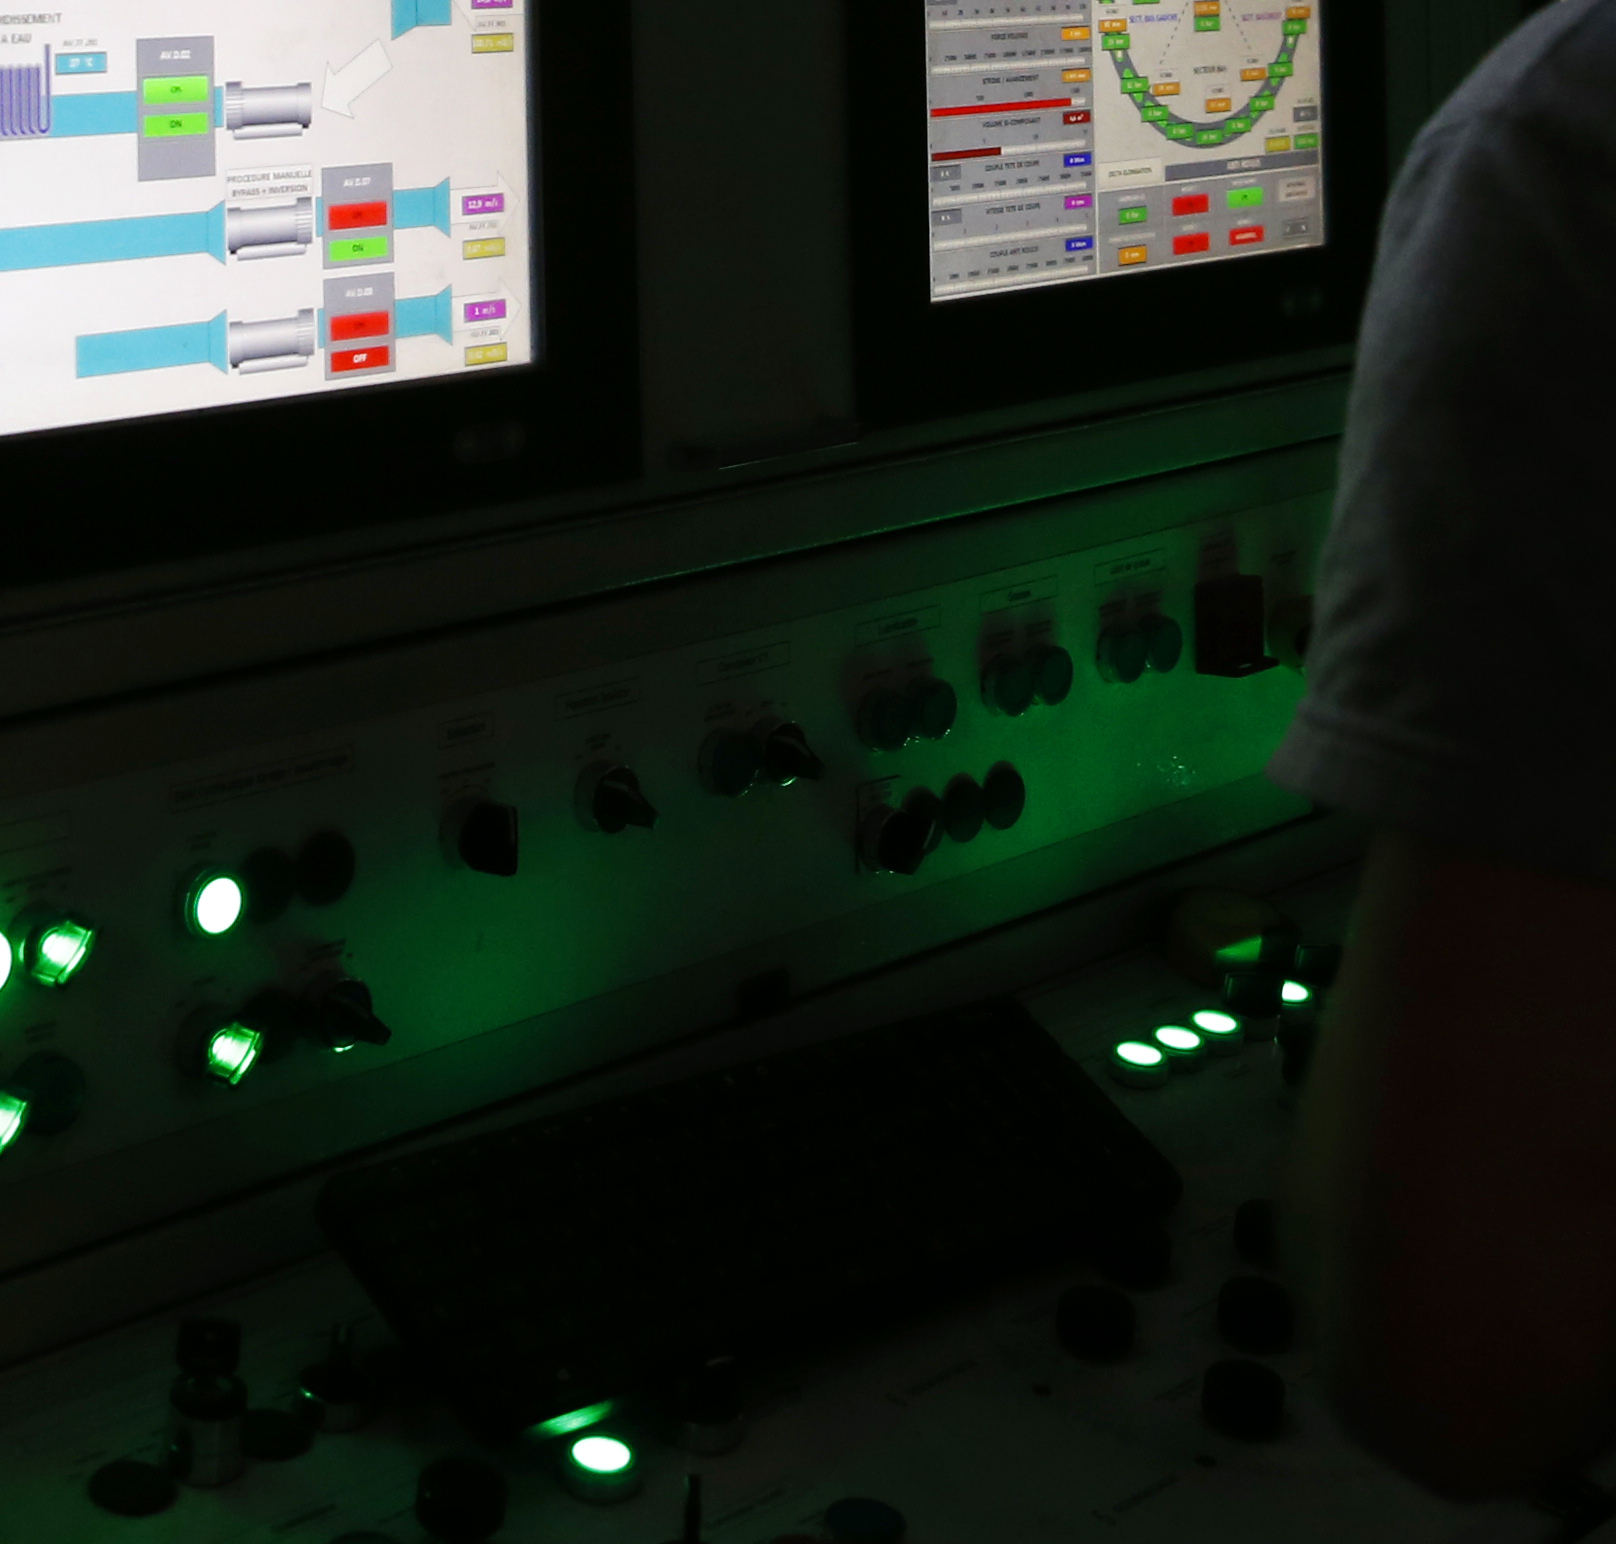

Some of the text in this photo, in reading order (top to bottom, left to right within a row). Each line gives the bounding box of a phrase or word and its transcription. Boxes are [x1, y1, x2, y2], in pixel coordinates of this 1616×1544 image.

[227, 168, 313, 183] PROCEDURE MANUELLE
[232, 186, 262, 198] BYPASS
[352, 353, 368, 364] OFF
